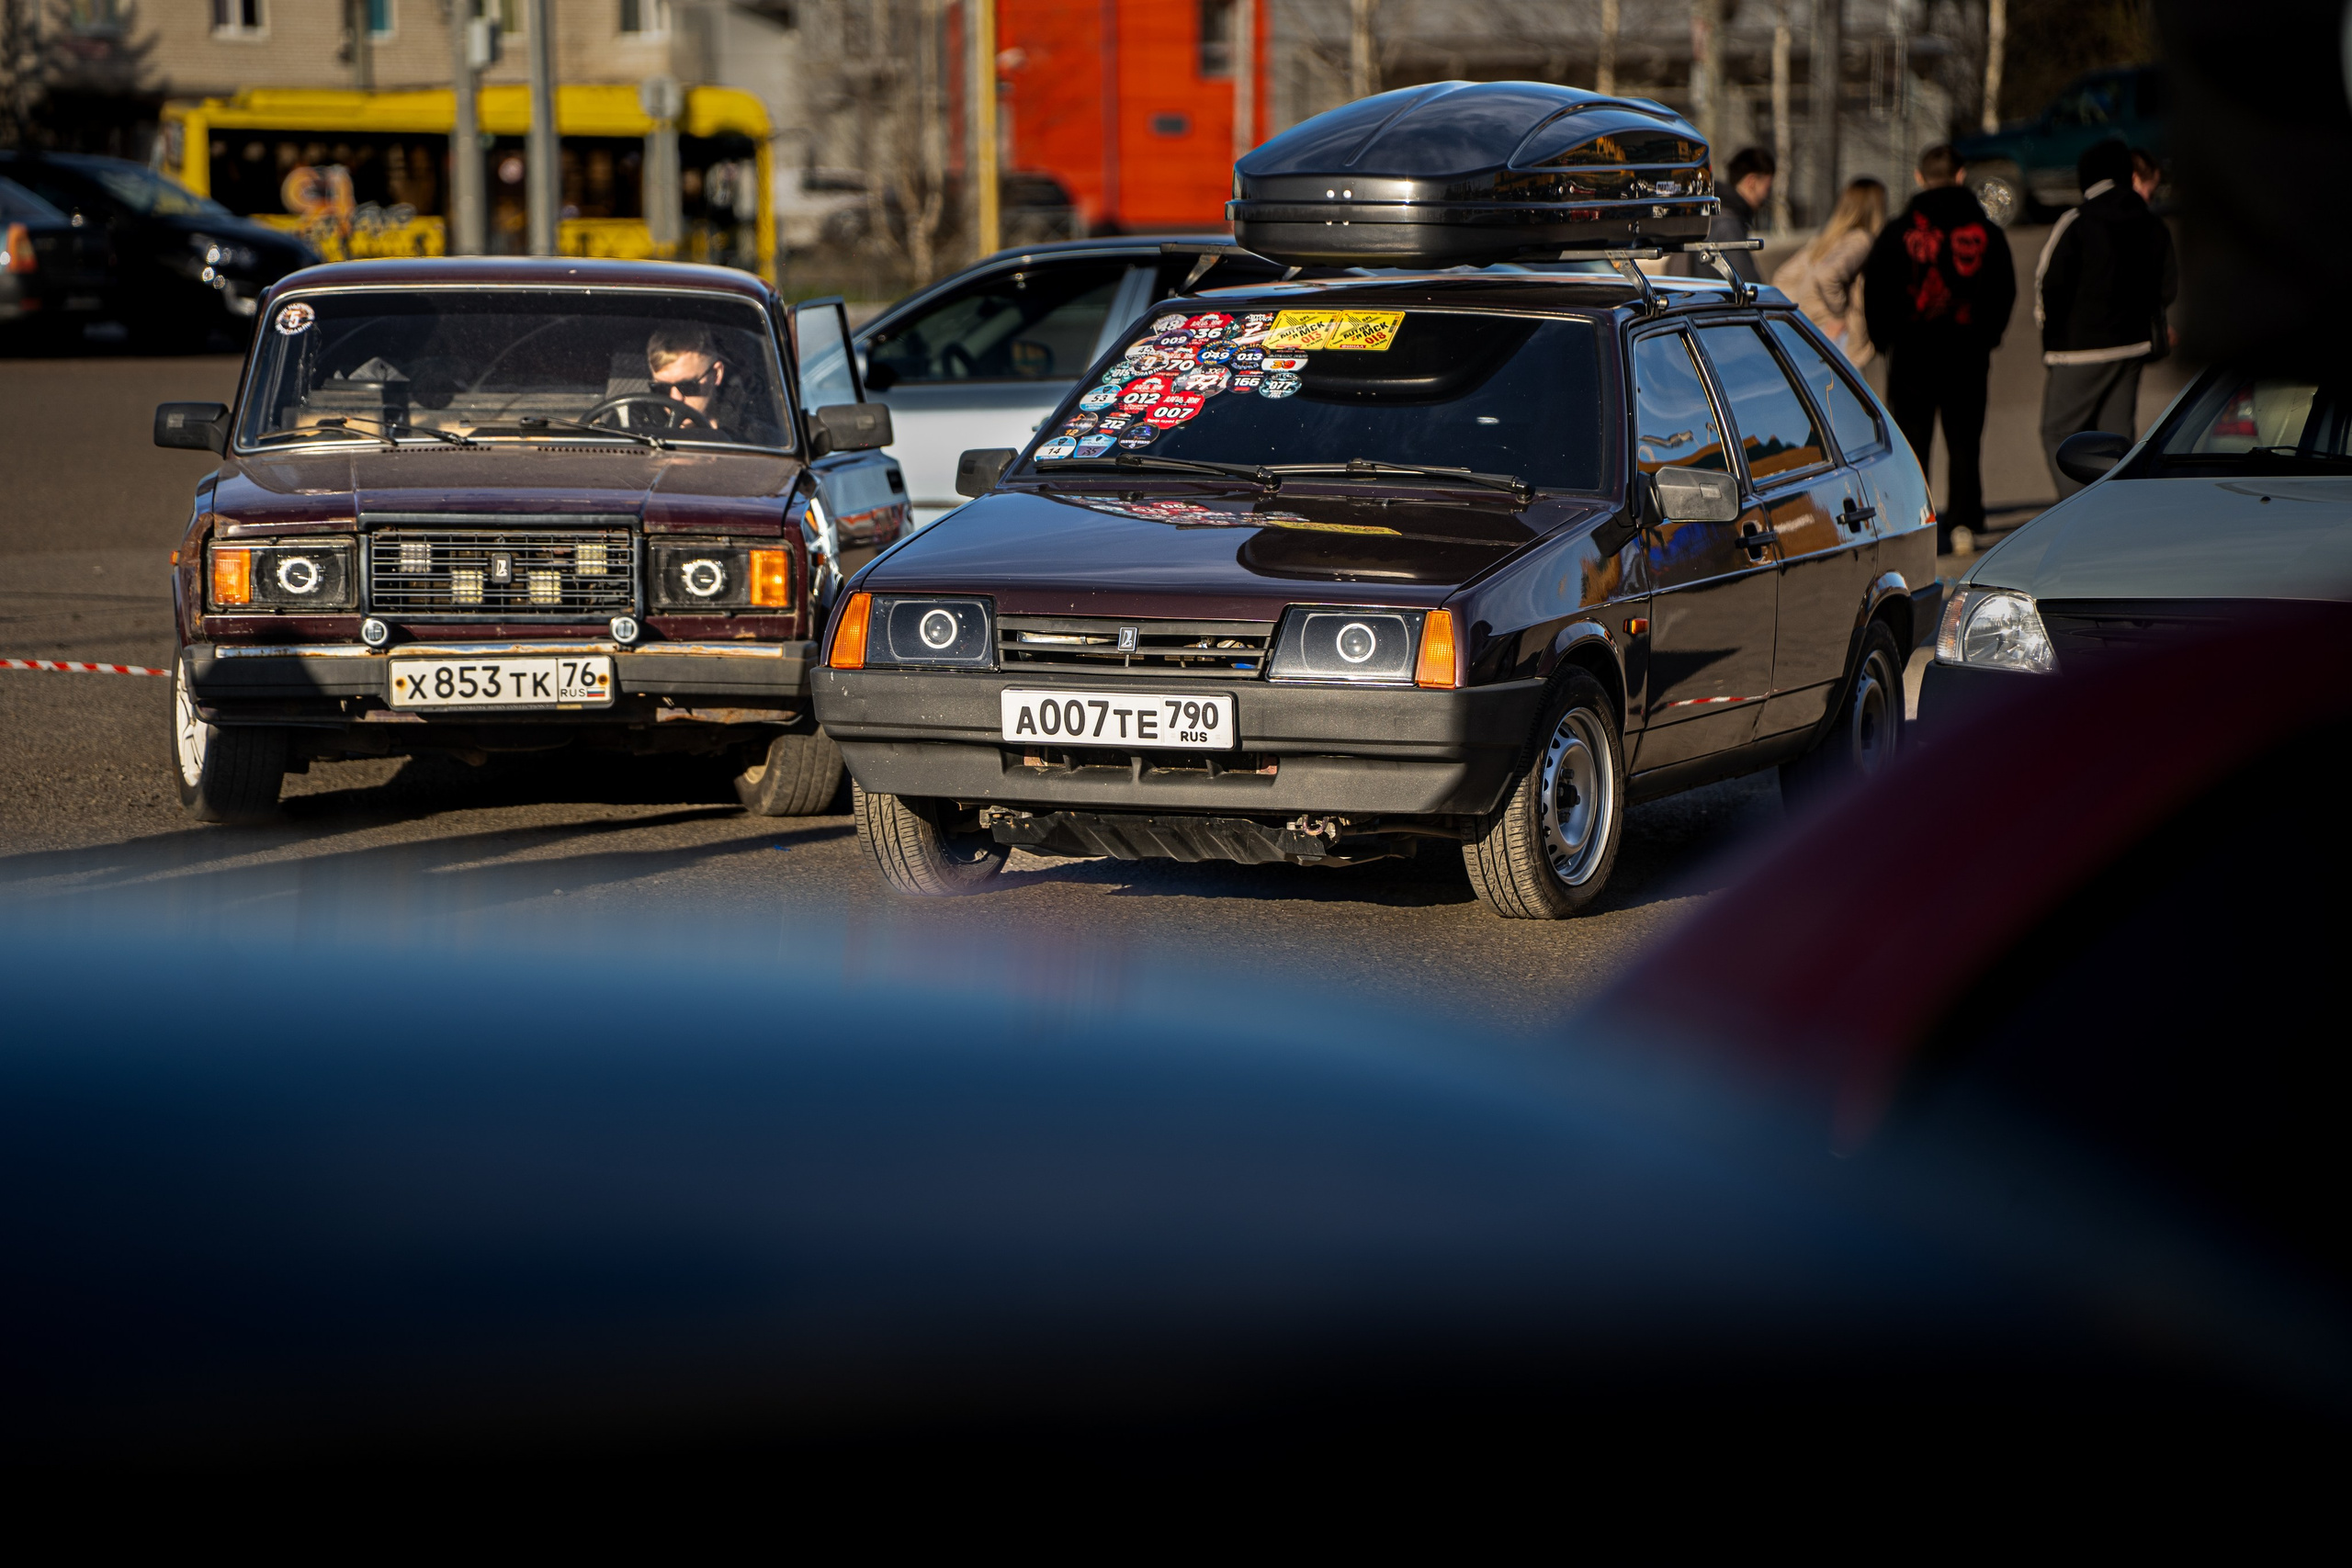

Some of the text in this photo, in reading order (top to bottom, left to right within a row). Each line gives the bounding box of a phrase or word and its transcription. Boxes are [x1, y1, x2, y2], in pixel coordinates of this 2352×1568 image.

[288, 310, 300, 328] 5
[1160, 336, 1187, 344] 009
[1301, 331, 1322, 344] 013
[1364, 332, 1386, 344] 018
[1237, 353, 1263, 361] 013
[1141, 356, 1157, 371] 9
[1270, 360, 1296, 369] 39
[1234, 378, 1261, 386] 166
[1269, 381, 1293, 389] 077
[1091, 394, 1108, 402] 53
[1123, 392, 1161, 404] 012
[1153, 407, 1194, 419] 007
[1100, 419, 1126, 430] 212
[1048, 446, 1062, 455] 14
[562, 661, 596, 687] 76
[560, 688, 585, 697] RUS
[1015, 698, 1219, 739] А007ТЕ 790
[1181, 731, 1208, 742] RUS
